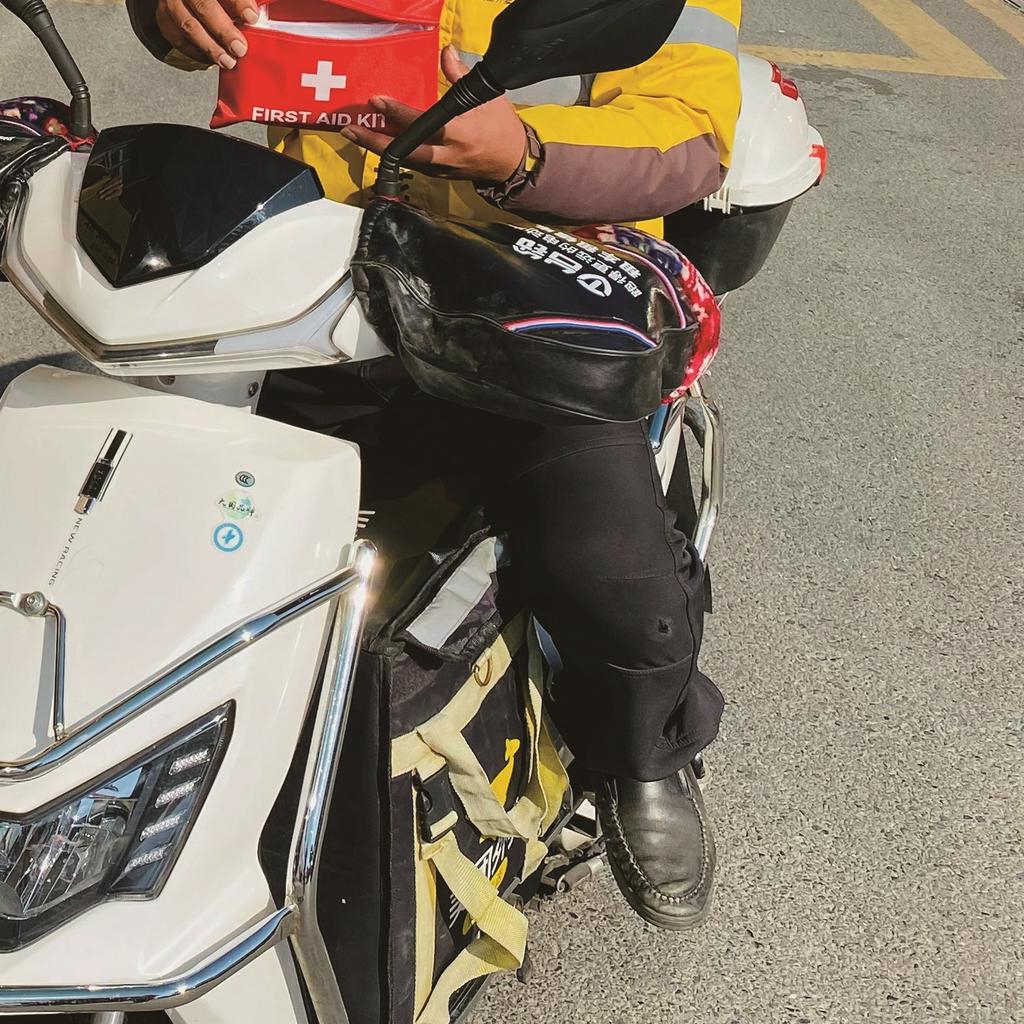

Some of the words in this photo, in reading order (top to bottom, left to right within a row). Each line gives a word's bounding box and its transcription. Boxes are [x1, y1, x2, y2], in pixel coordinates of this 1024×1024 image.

[251, 105, 312, 124] FIRST
[315, 112, 352, 126] AID
[510, 223, 643, 298] 跑得更远的电动
[64, 517, 83, 545] NEW
[47, 545, 70, 587] RACING
